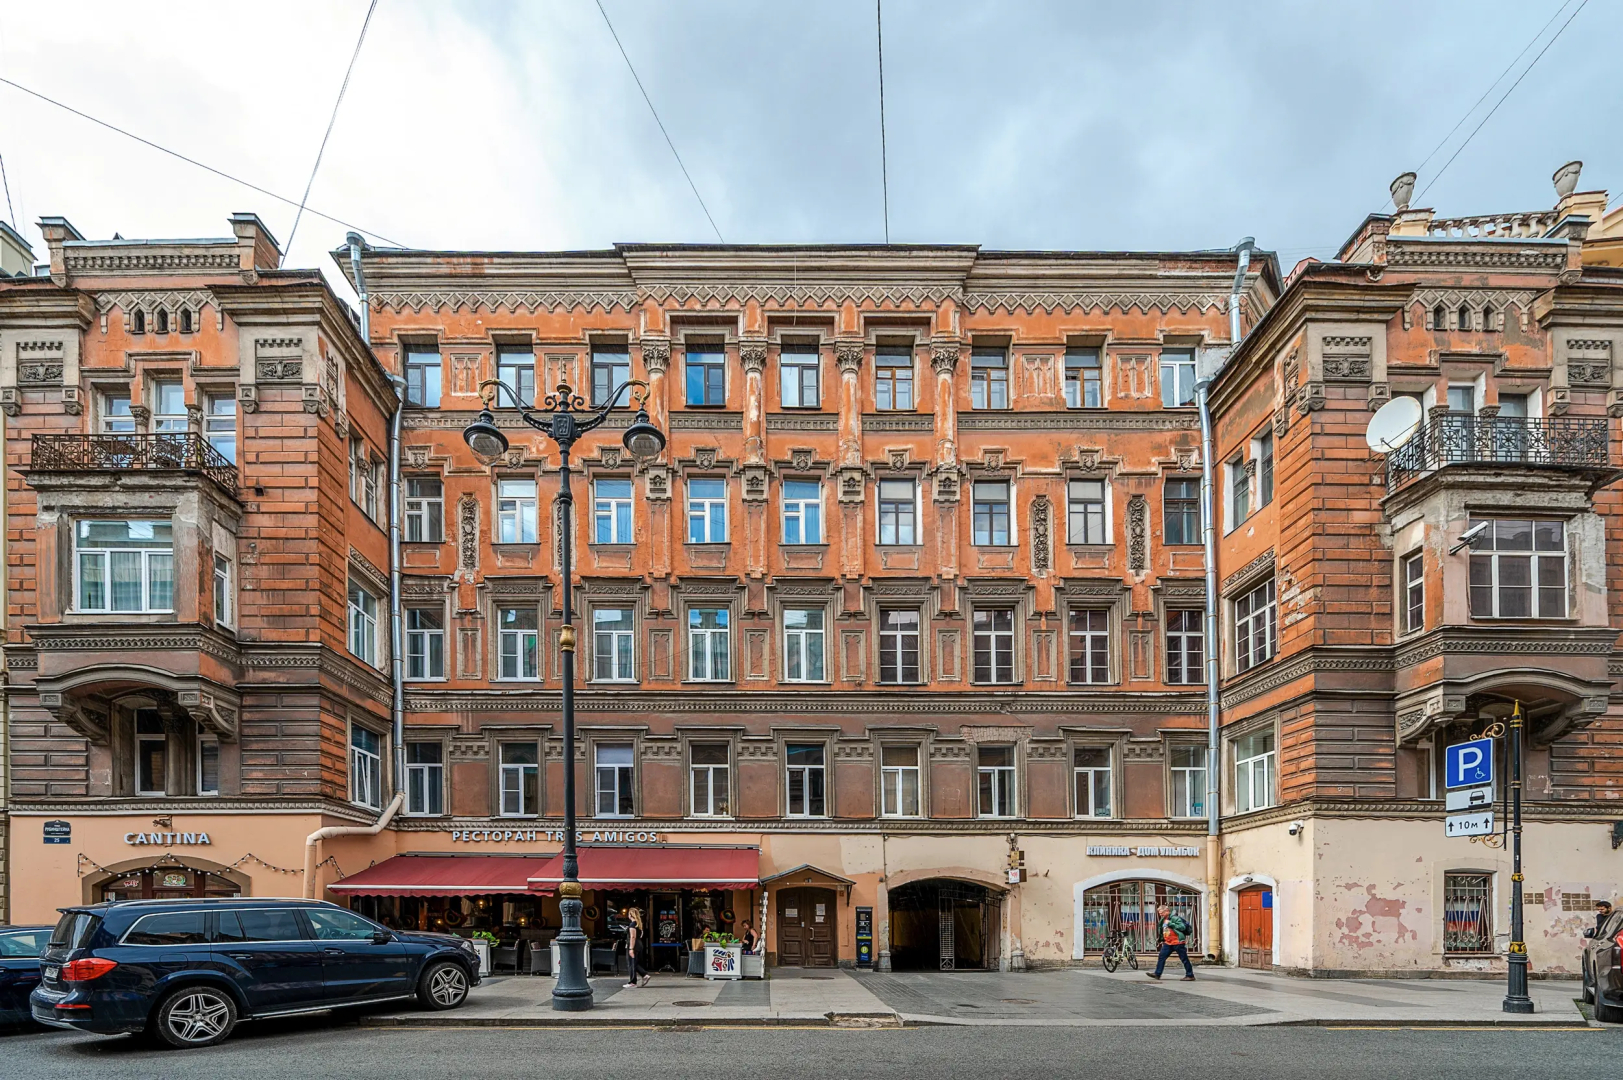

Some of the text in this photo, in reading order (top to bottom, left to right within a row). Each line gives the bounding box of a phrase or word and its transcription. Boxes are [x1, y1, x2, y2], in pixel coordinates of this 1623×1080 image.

[1458, 747, 1483, 782] P
[123, 832, 210, 845] CANTINA
[452, 831, 658, 842] РЕСТОРАН TRS AMIGOS
[1086, 846, 1200, 858] КЛИНИКА ДОМ УЛЫБОК
